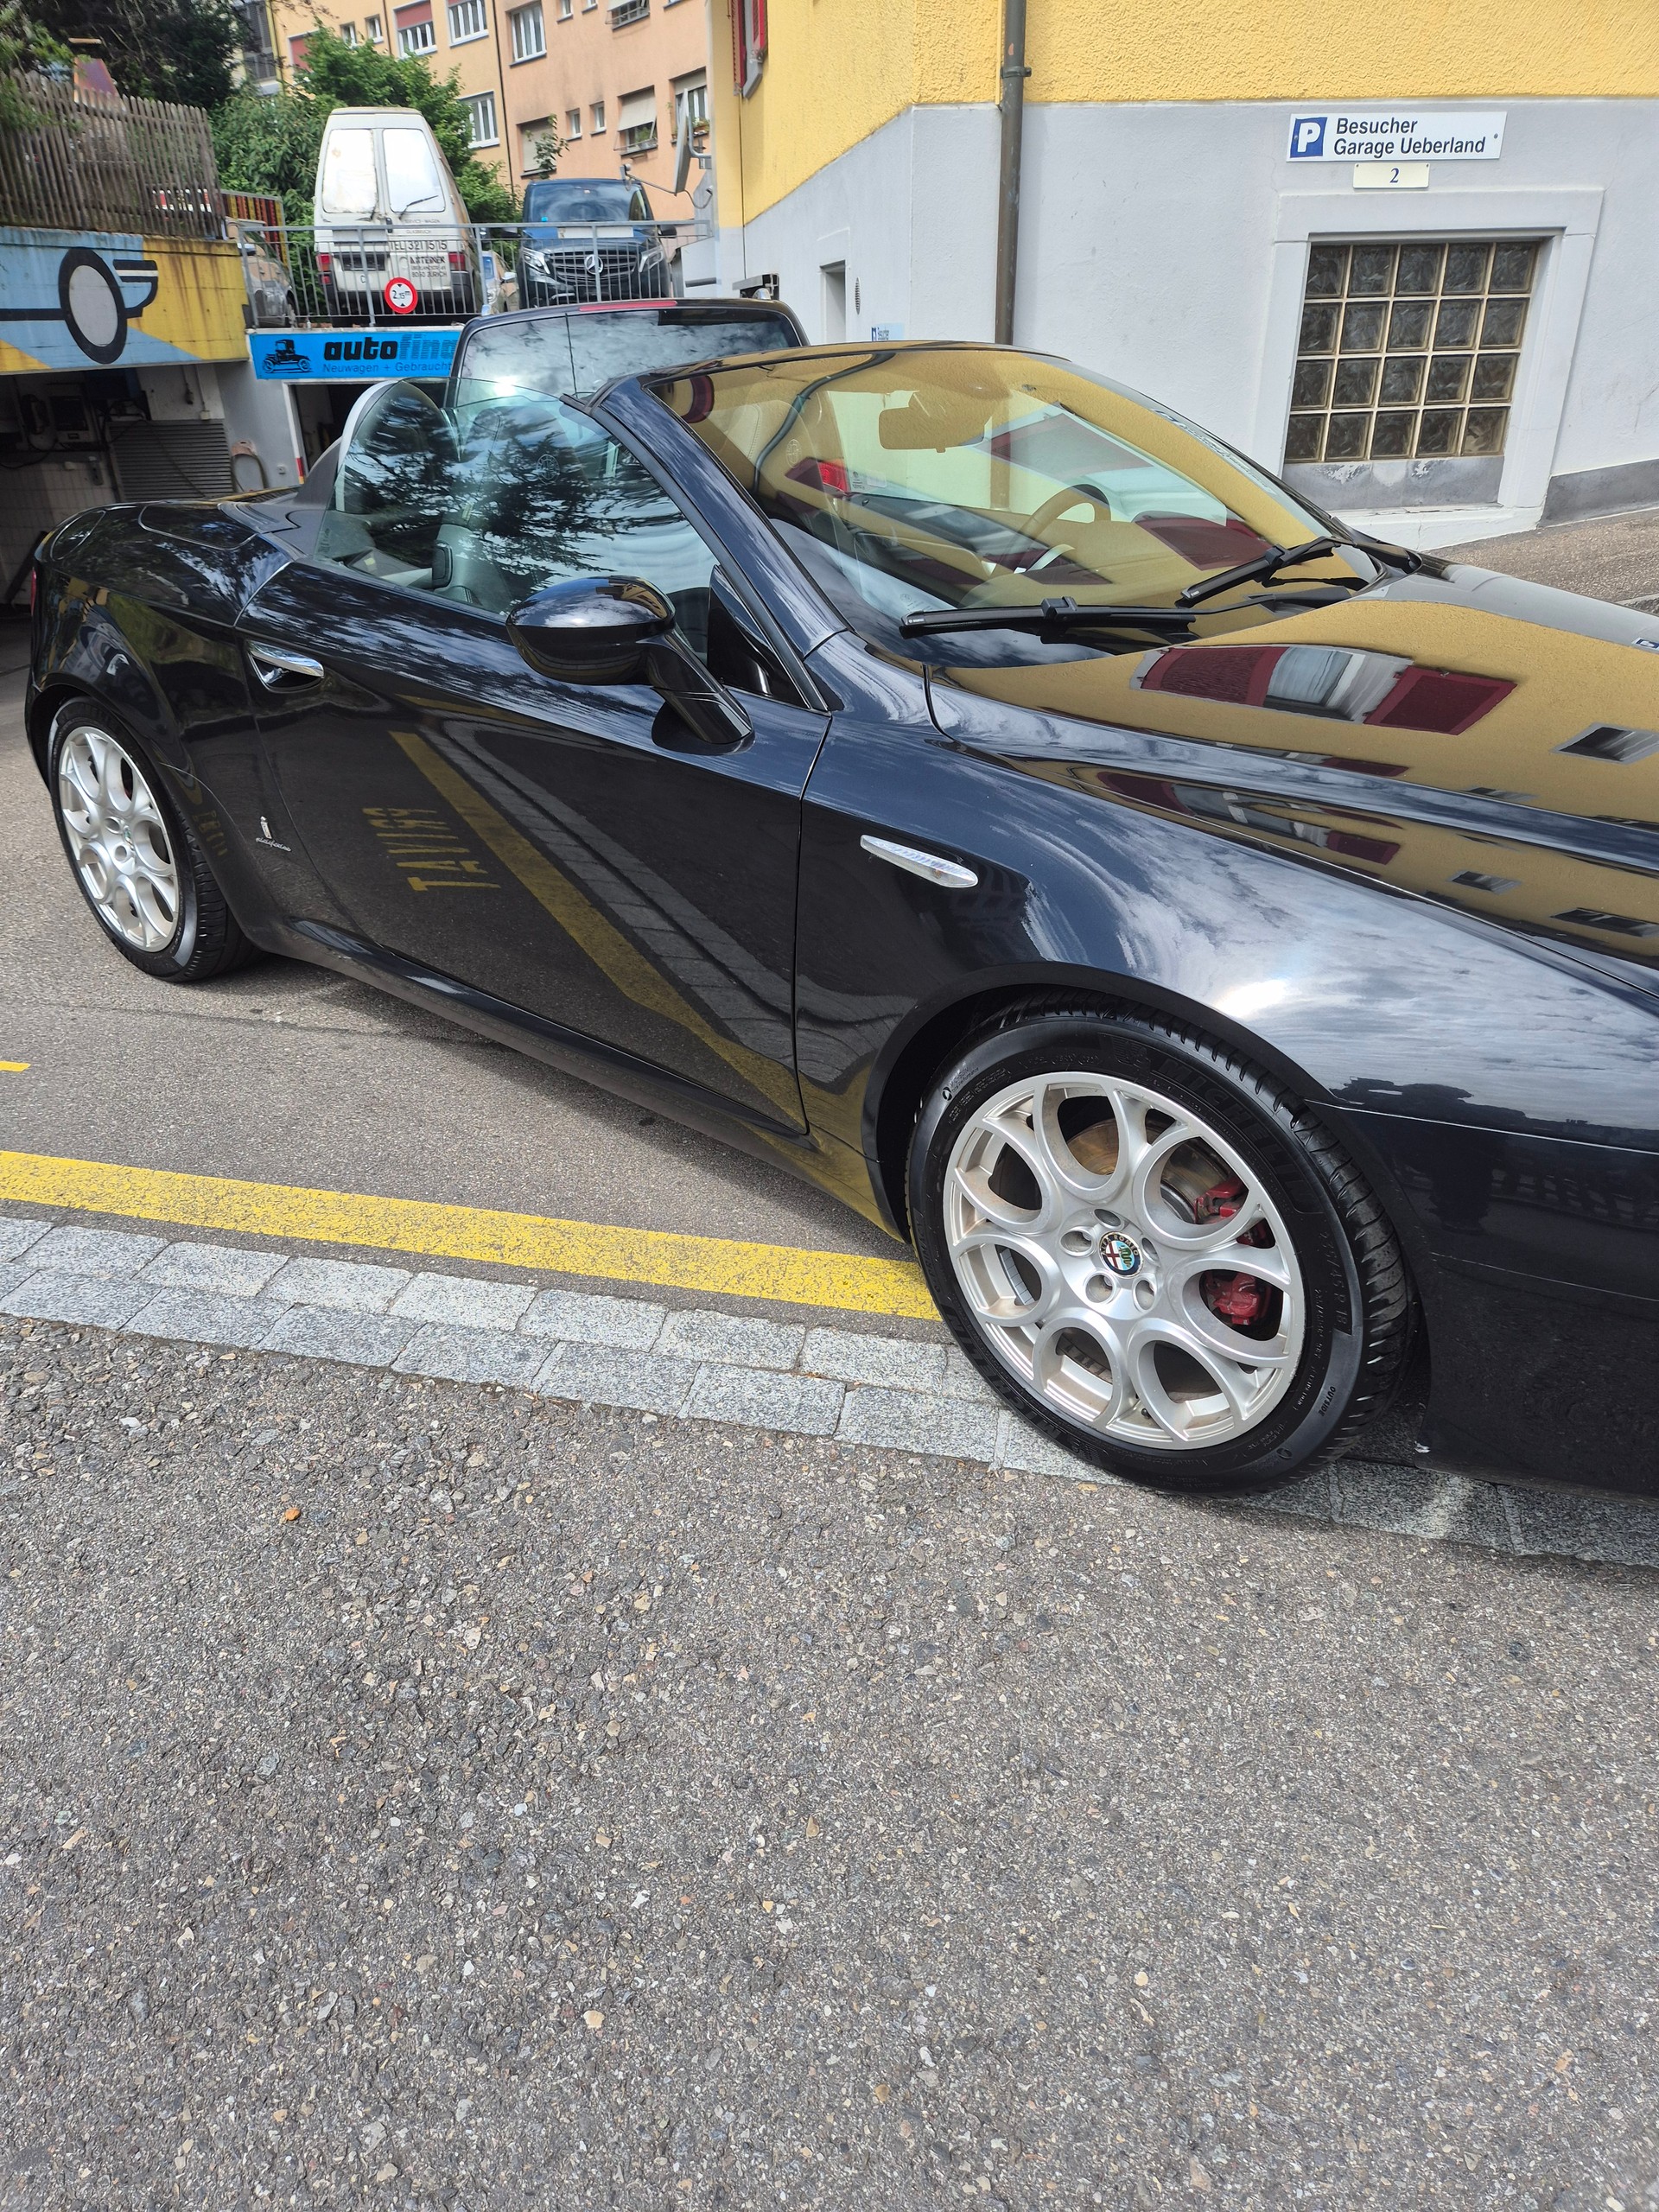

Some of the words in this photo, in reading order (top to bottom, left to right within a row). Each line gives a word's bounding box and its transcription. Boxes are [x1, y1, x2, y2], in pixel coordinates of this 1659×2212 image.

[1336, 117, 1418, 135] Besucher
[1297, 122, 1321, 153] P
[1333, 137, 1395, 159] Garage
[1399, 136, 1487, 155] Ueberland
[1389, 168, 1400, 183] 2
[322, 364, 379, 374] Neuwagen
[1113, 1234, 1139, 1256] ROMEO
[1318, 1385, 1337, 1417] OUTSIDE
